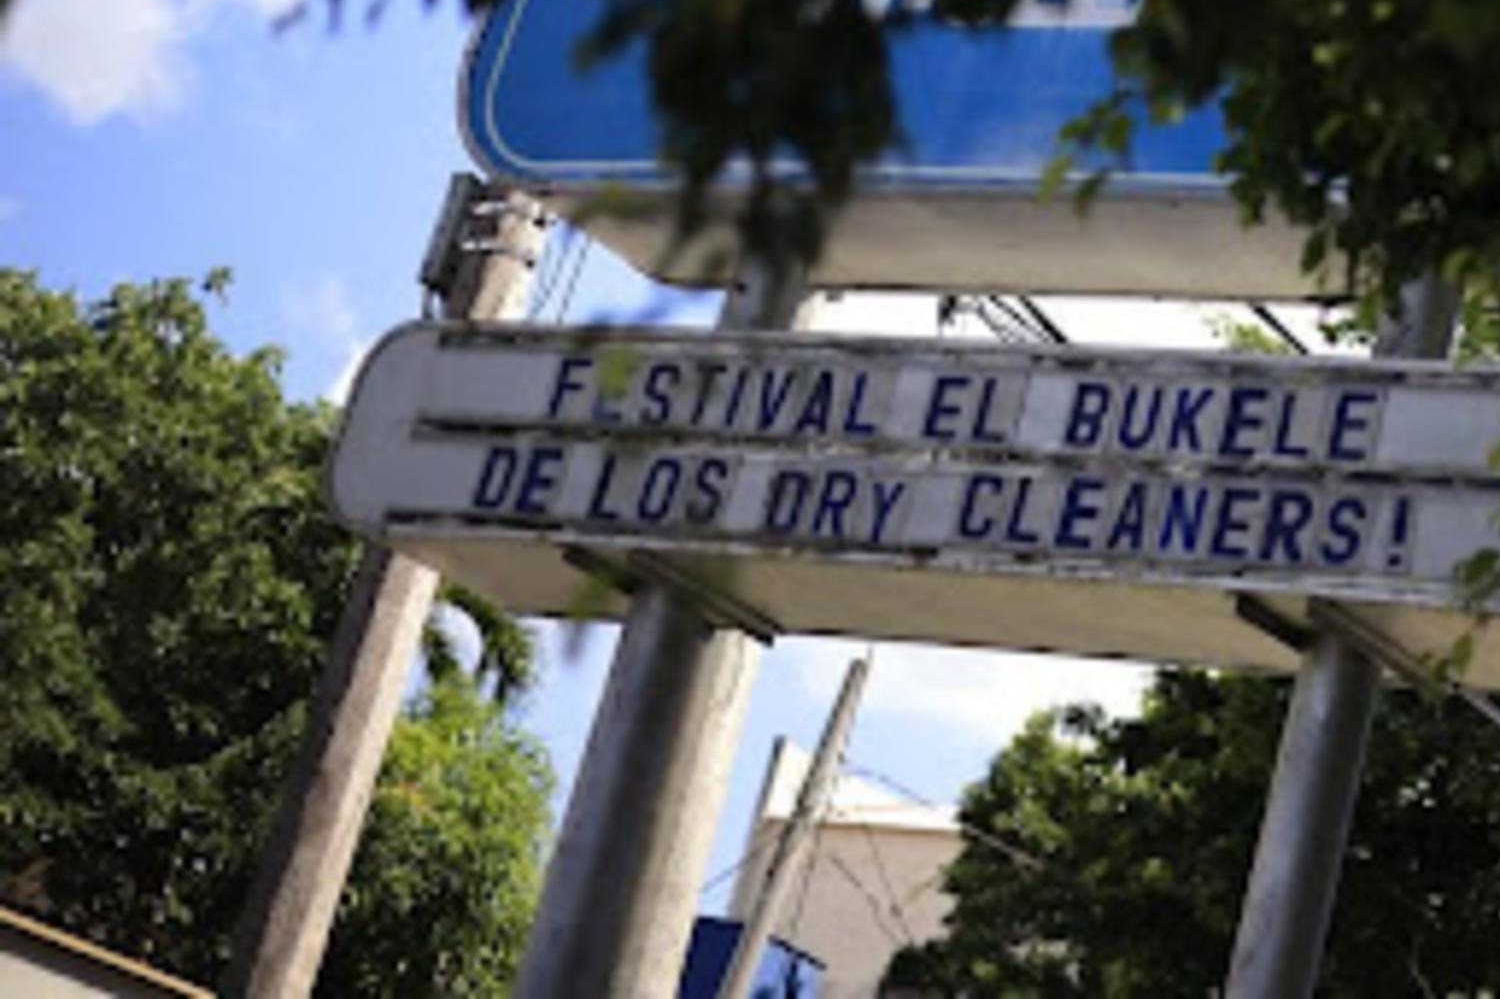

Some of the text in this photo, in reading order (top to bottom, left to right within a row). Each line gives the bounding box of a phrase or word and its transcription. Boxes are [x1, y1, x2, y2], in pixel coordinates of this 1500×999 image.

[922, 375, 1008, 442] EL
[1064, 383, 1378, 461] BUKELE
[473, 447, 1411, 567] DE LOS DRY CLEANERS!
